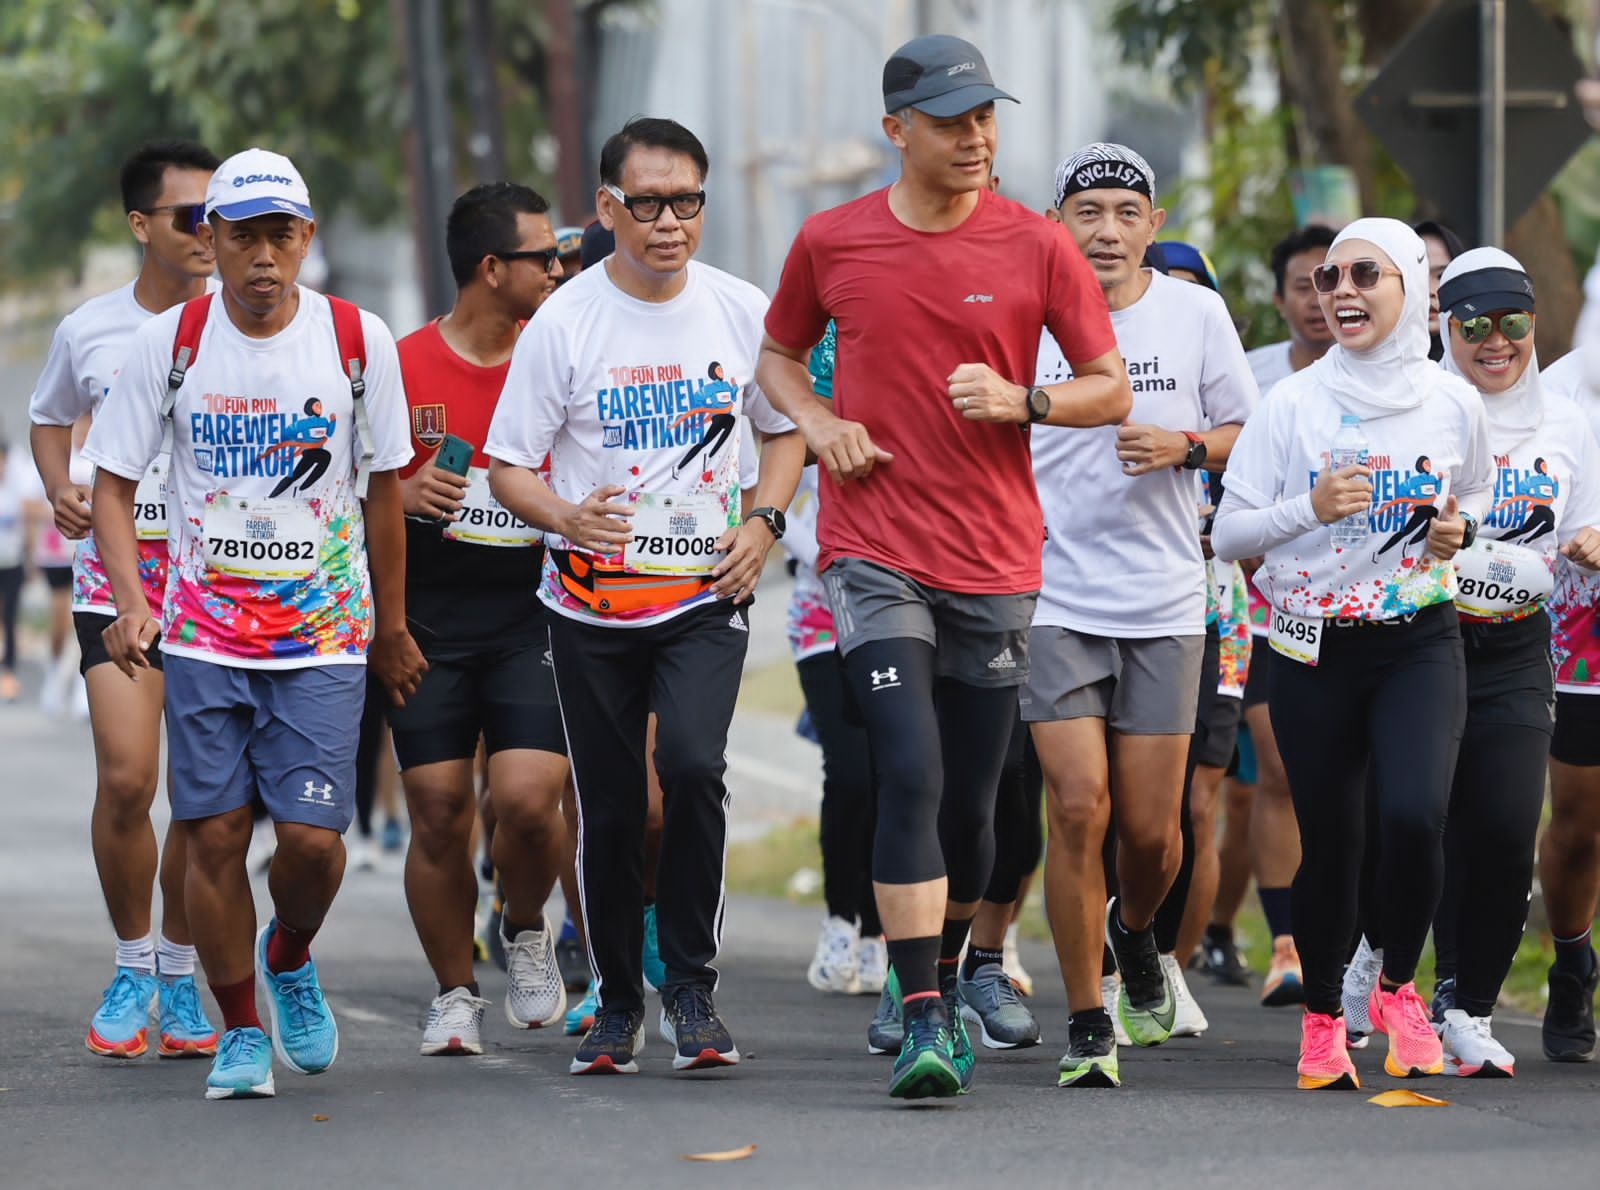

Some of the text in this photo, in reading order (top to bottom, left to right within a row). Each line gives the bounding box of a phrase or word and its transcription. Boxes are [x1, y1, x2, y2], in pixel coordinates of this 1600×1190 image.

[245, 174, 292, 187] GIANT
[1076, 163, 1144, 188] CYCLIST
[631, 367, 655, 385] FUN
[657, 364, 682, 382] RUN
[1130, 377, 1176, 392] ama
[225, 398, 248, 414] FUN
[251, 398, 277, 413] RUN
[623, 413, 705, 450] ATIKOH
[213, 445, 295, 479] ATIKOH
[1367, 455, 1390, 470] RUN
[246, 520, 277, 531] FAREWELL
[209, 537, 314, 560] 7810082
